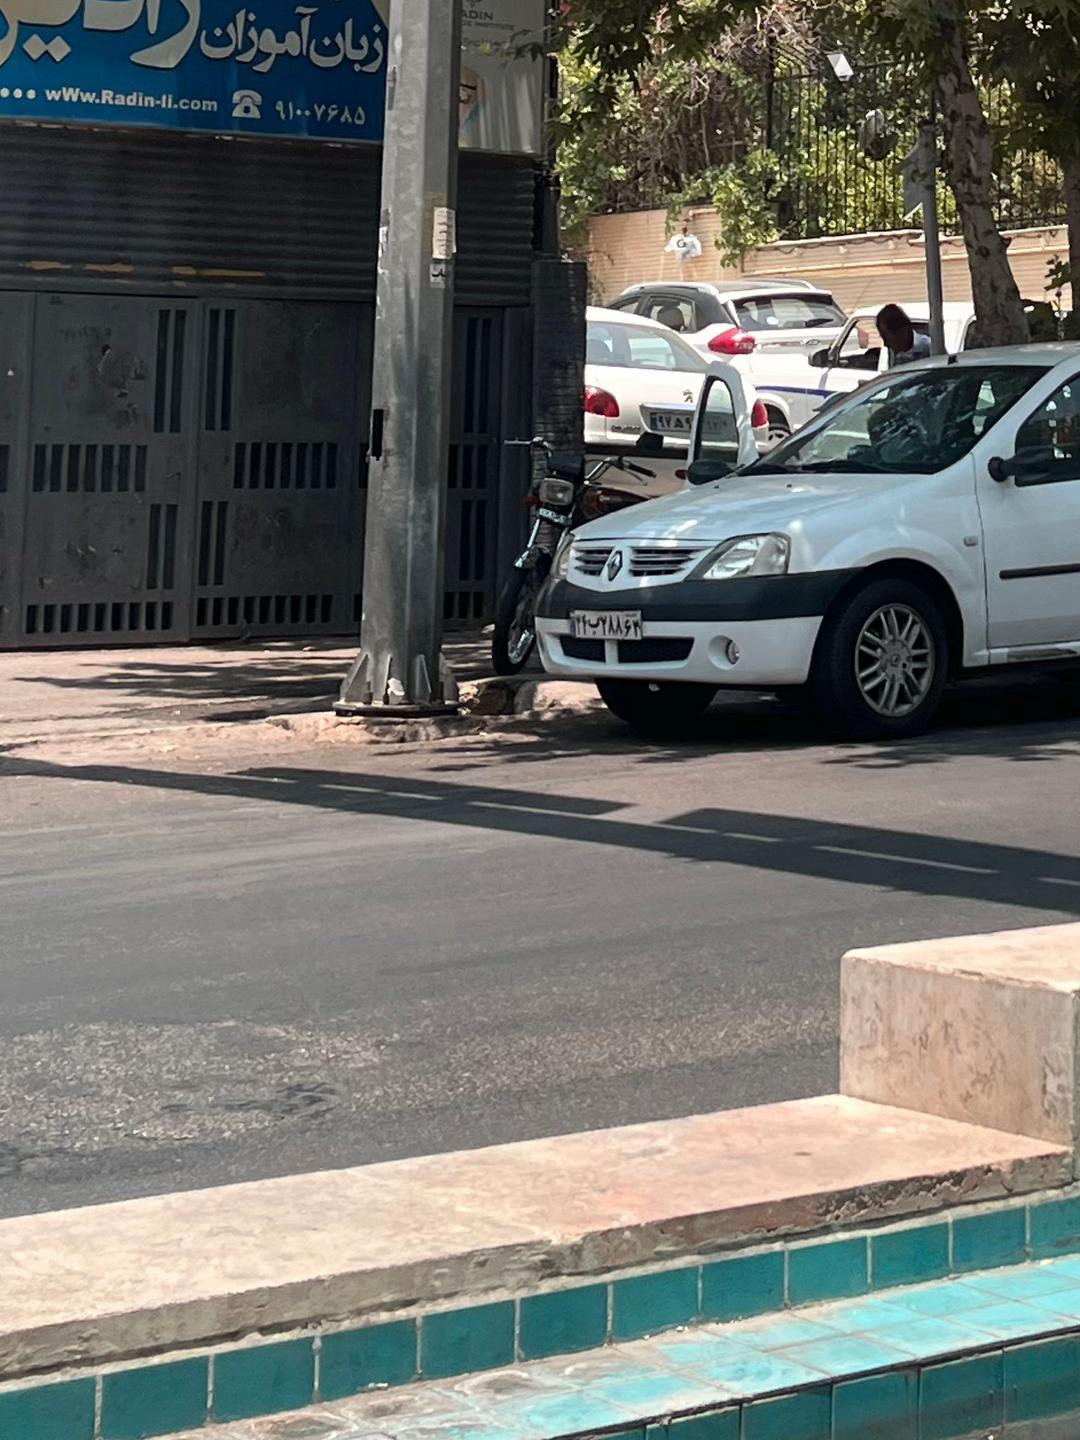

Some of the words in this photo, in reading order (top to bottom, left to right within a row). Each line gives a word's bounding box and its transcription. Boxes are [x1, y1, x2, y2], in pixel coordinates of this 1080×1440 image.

[460, 9, 493, 21] ADIN
[200, 6, 319, 73] آموزان
[308, 17, 384, 73] زبان
[275, 100, 366, 125] ۹۱۰۰۷۶۸۵
